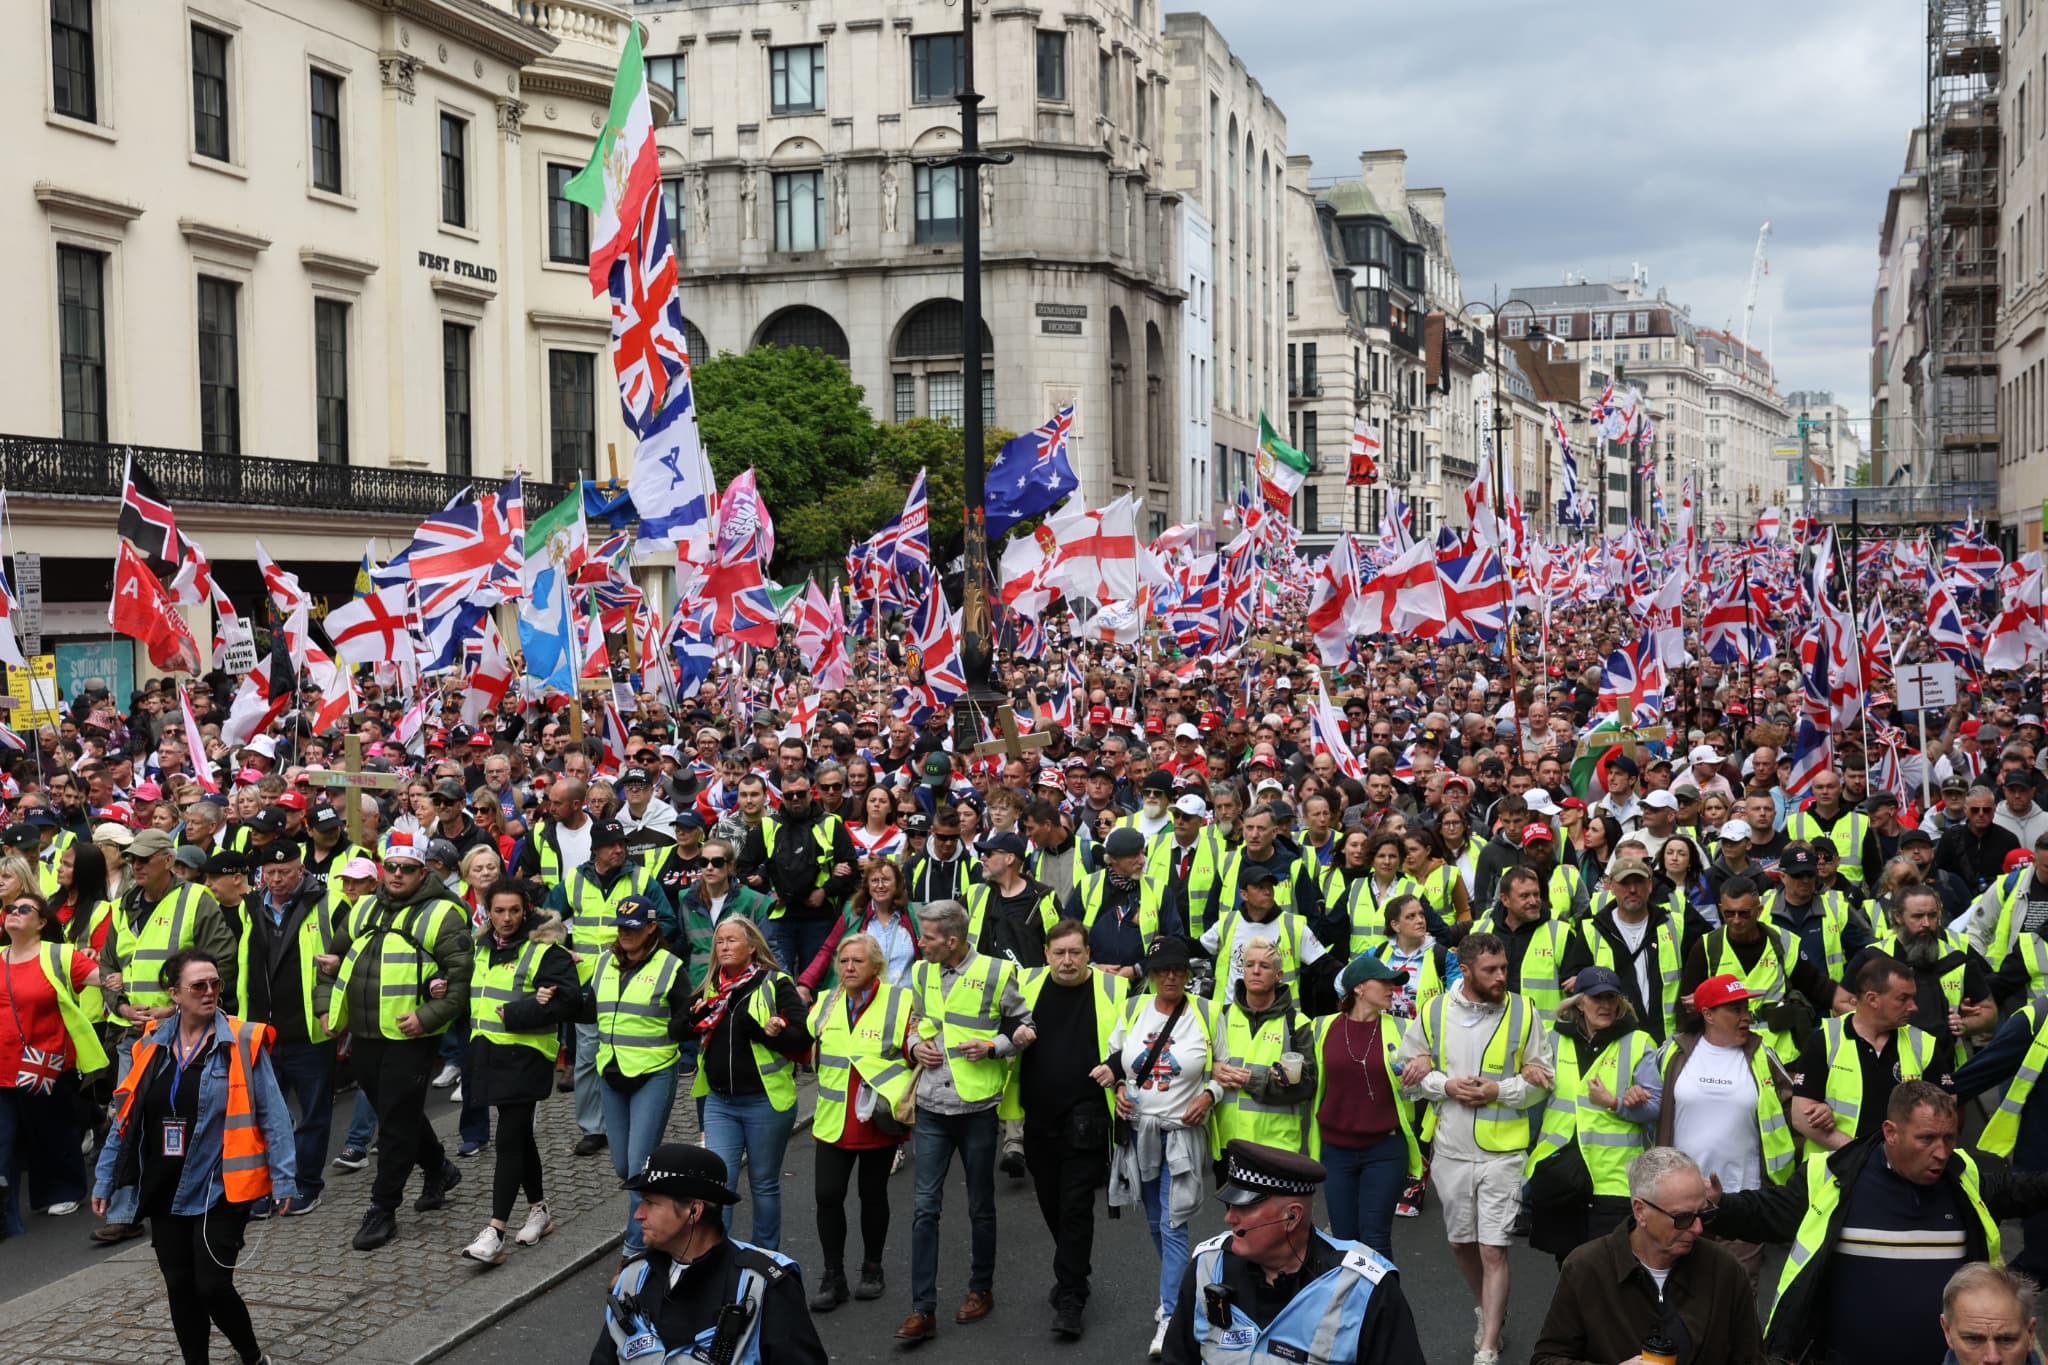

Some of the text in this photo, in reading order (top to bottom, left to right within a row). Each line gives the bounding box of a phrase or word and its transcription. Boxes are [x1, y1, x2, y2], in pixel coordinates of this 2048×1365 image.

[418, 250, 497, 283] WEST STRAND
[1038, 305, 1085, 316] ZIMBABWE
[1048, 322, 1077, 332] HOUSE
[225, 650, 253, 660] LEAVING
[70, 659, 118, 678] SWIRLING
[230, 661, 253, 669] PARTY
[618, 901, 640, 915] 47
[1700, 1076, 1733, 1085] adidas
[626, 1336, 652, 1353] POLICE
